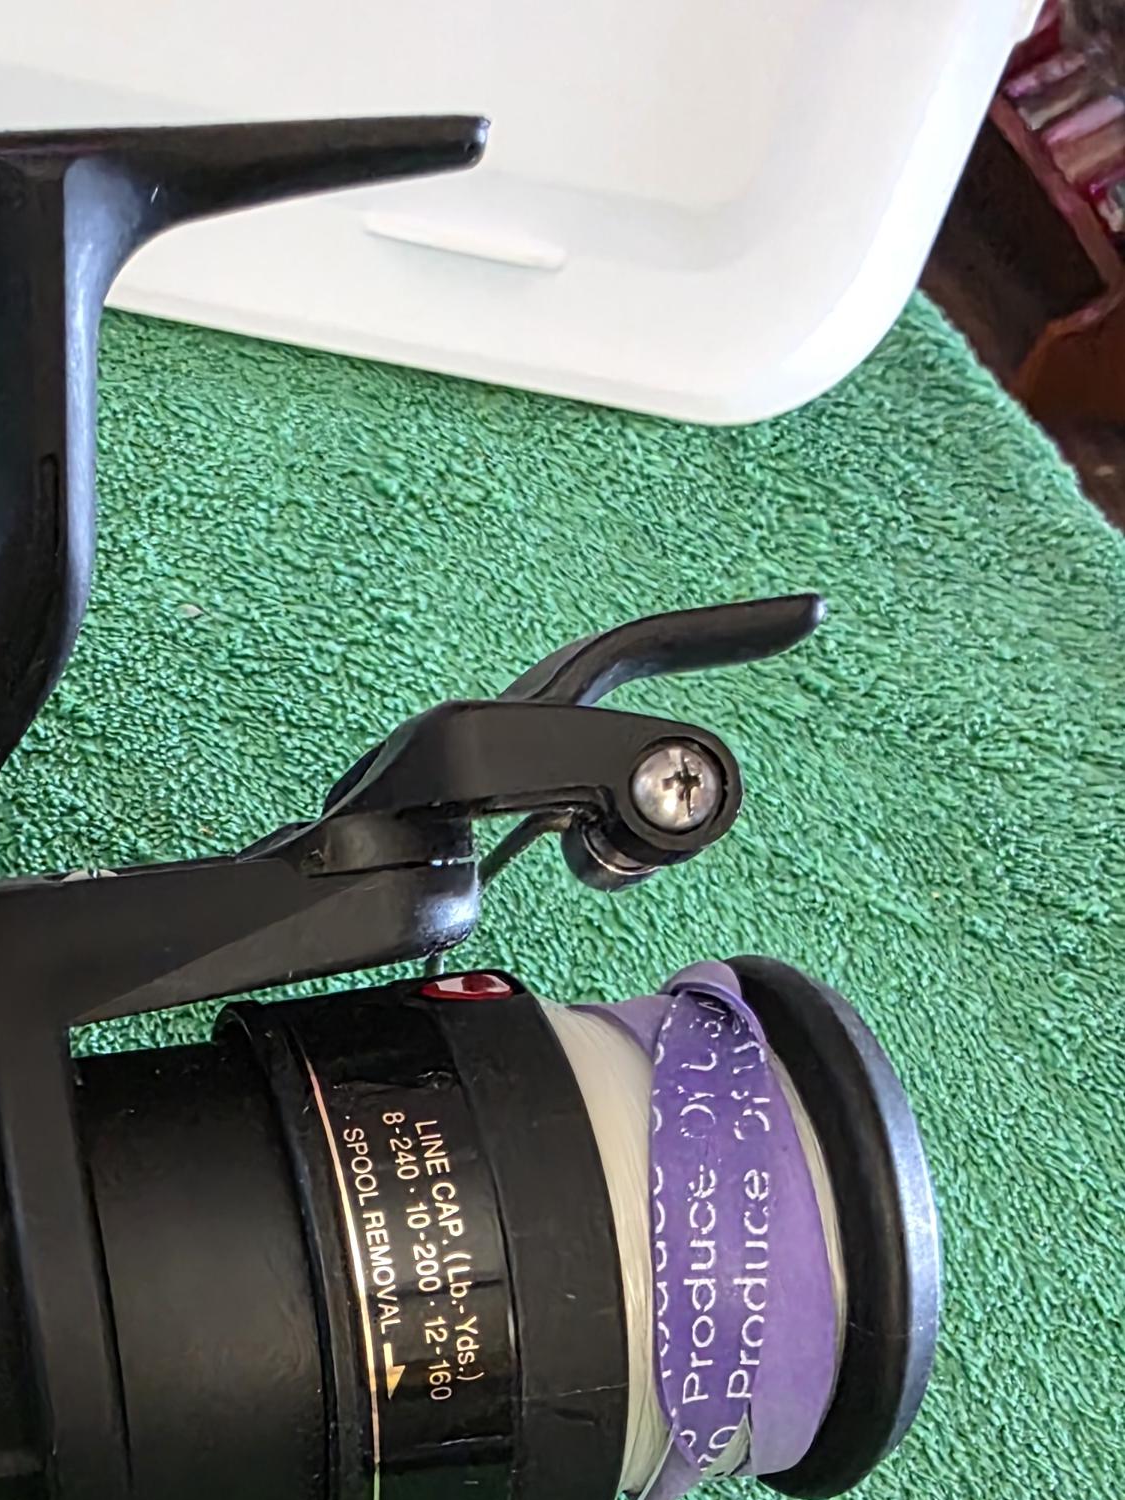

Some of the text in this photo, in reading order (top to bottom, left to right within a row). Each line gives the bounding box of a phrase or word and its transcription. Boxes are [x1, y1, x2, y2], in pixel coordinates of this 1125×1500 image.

[343, 1128, 401, 1335] SPOOL REMOVAL
[382, 1111, 452, 1400] 8-240 10-200 12-160
[415, 1120, 451, 1176] LINE
[431, 1182, 464, 1246] CAP.
[682, 1163, 718, 1404] Produce
[727, 1168, 770, 1400] Produce
